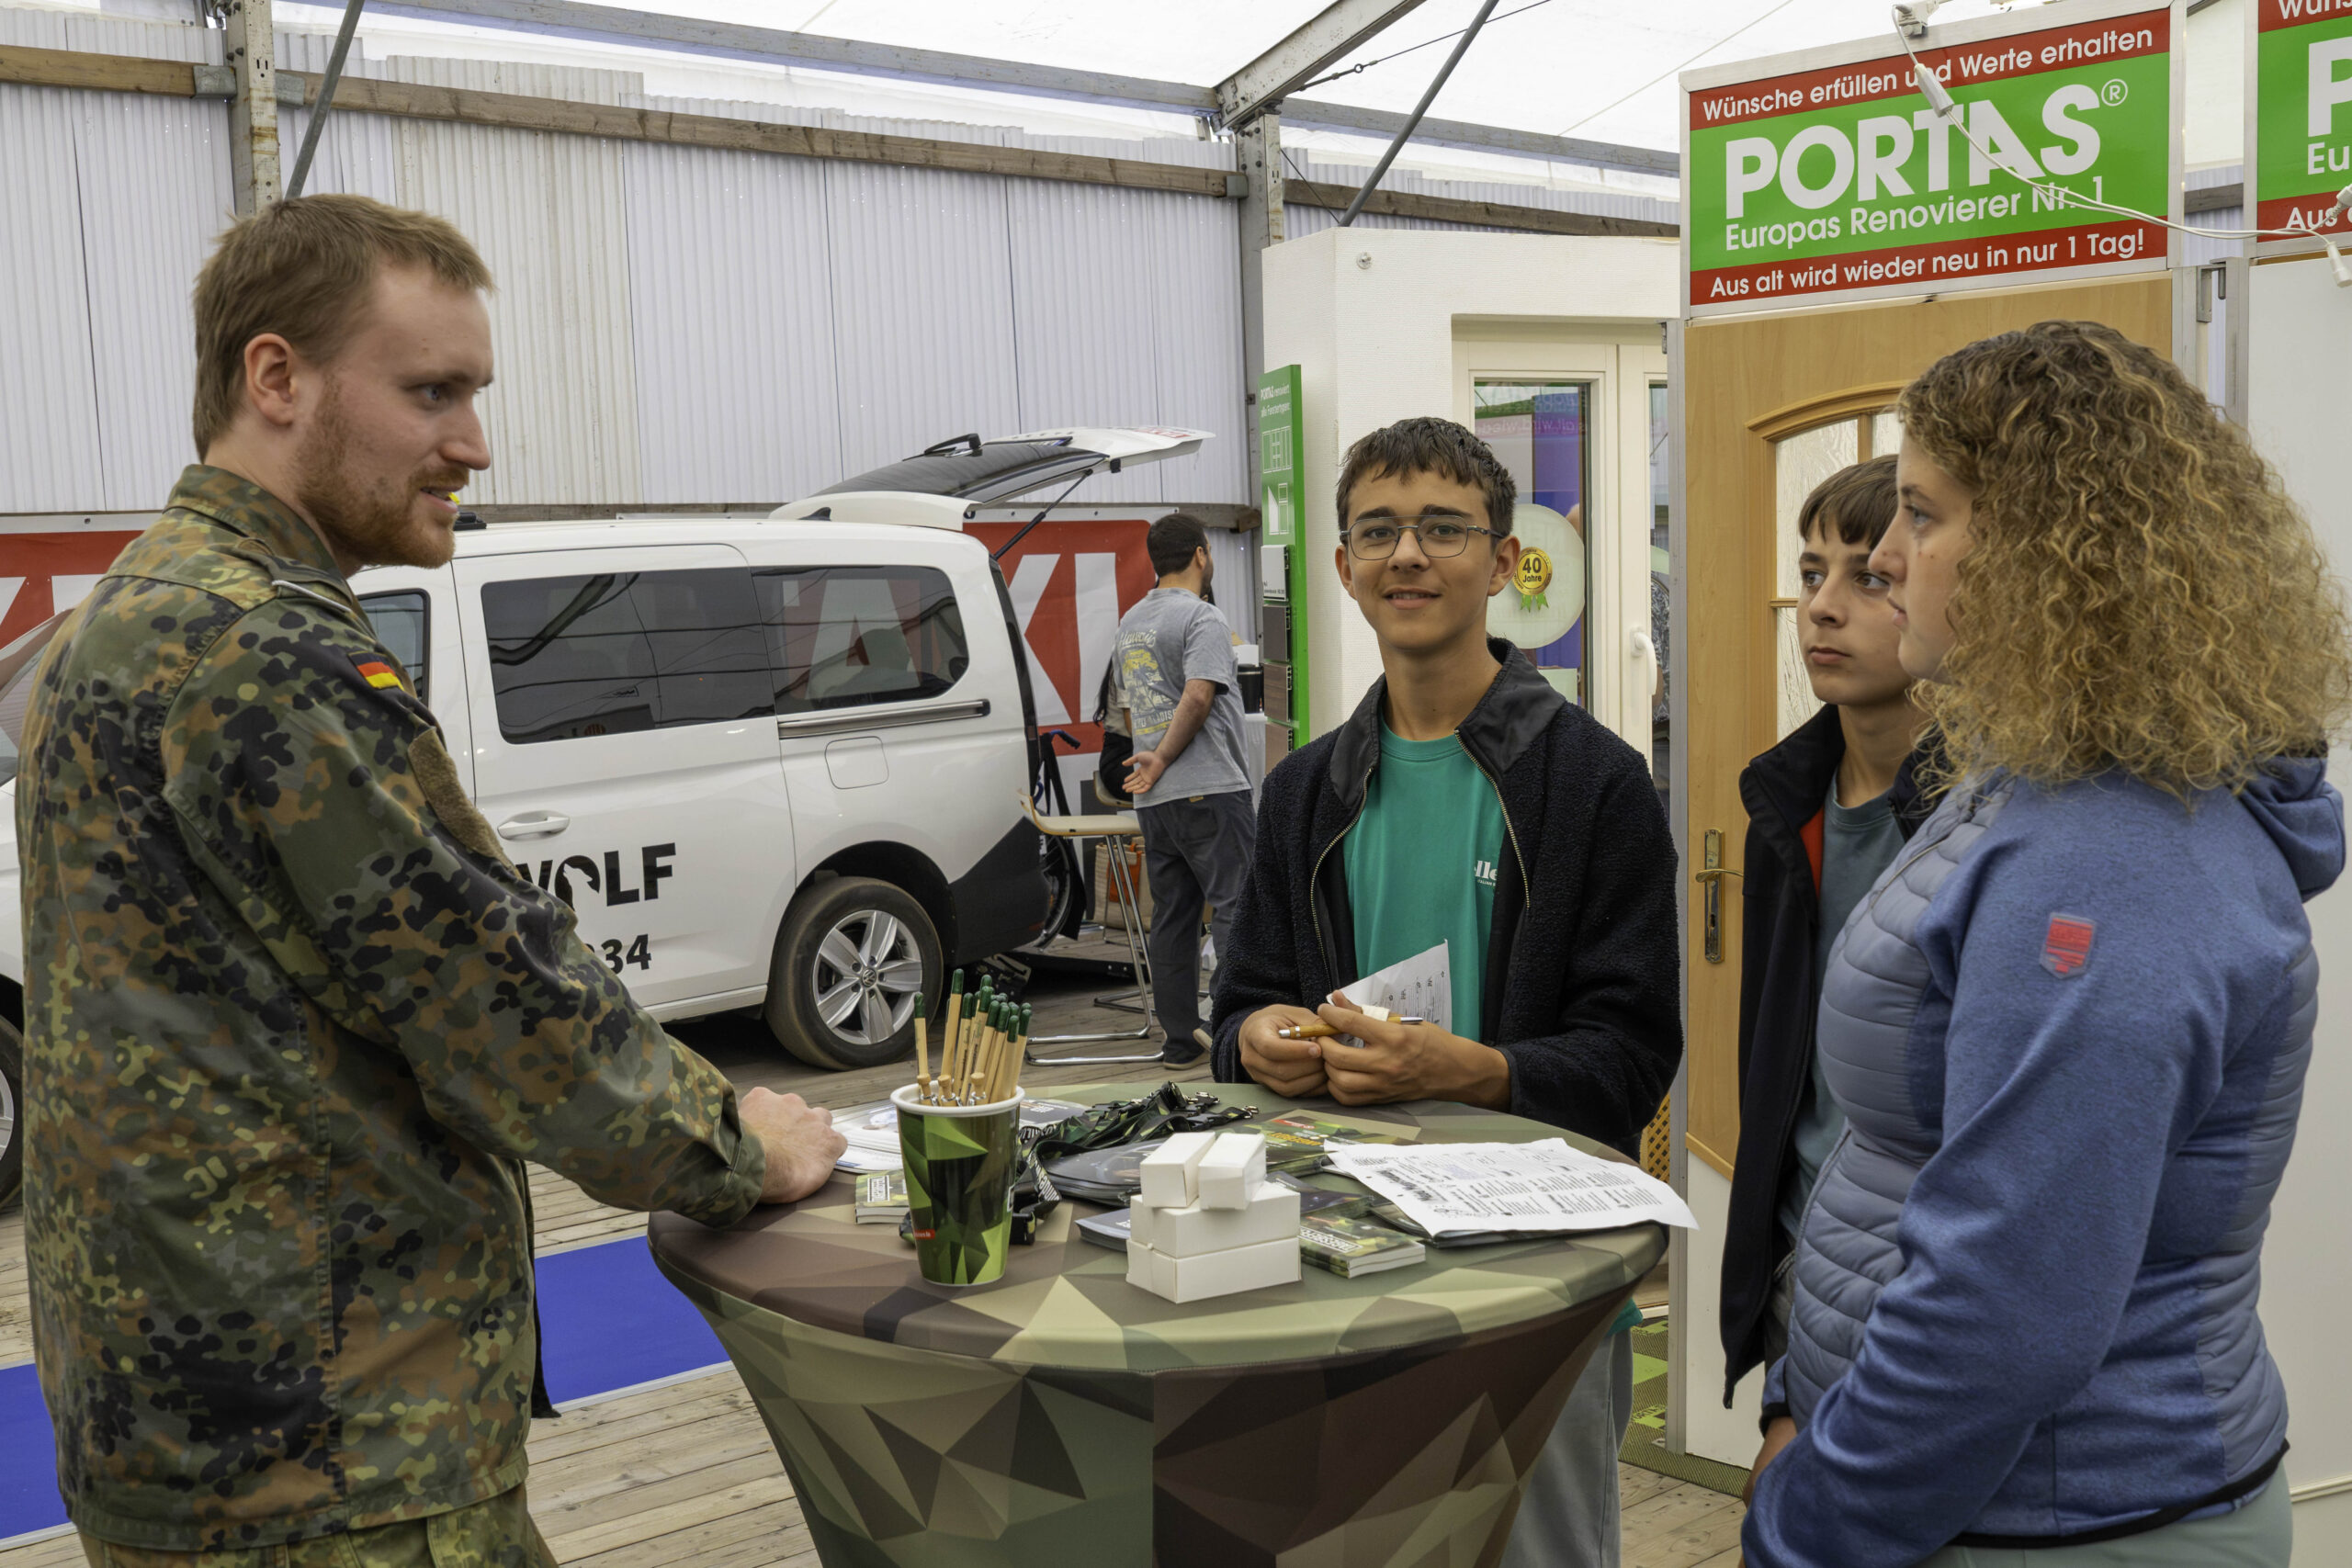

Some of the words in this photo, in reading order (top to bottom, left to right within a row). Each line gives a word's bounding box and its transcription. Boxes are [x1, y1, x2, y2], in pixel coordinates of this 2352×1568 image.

[1702, 89, 1803, 121] Wünsche
[1810, 73, 1897, 103] erfüllen
[1959, 48, 2033, 78] Werte
[2041, 28, 2153, 64] erhalten
[2308, 142, 2350, 175] Eu
[1725, 215, 1841, 251] Europas
[1850, 192, 2021, 235] Renovierer
[2031, 182, 2075, 213] Nr.
[2093, 175, 2103, 203] 1
[2285, 206, 2338, 231] Aus
[1711, 276, 1750, 299] Aus
[1756, 269, 1782, 292] alt
[1791, 263, 1838, 288] wird
[1844, 255, 1925, 283] wieder
[1932, 250, 1979, 274] neu
[1986, 245, 2008, 268] in
[2016, 241, 2058, 265] nur
[2067, 235, 2076, 258] 1
[2086, 228, 2145, 258] Tag!
[1522, 557, 1542, 573] 40
[1522, 574, 1543, 583] Jahre
[1474, 860, 1498, 881] lle
[585, 933, 652, 976] 34
